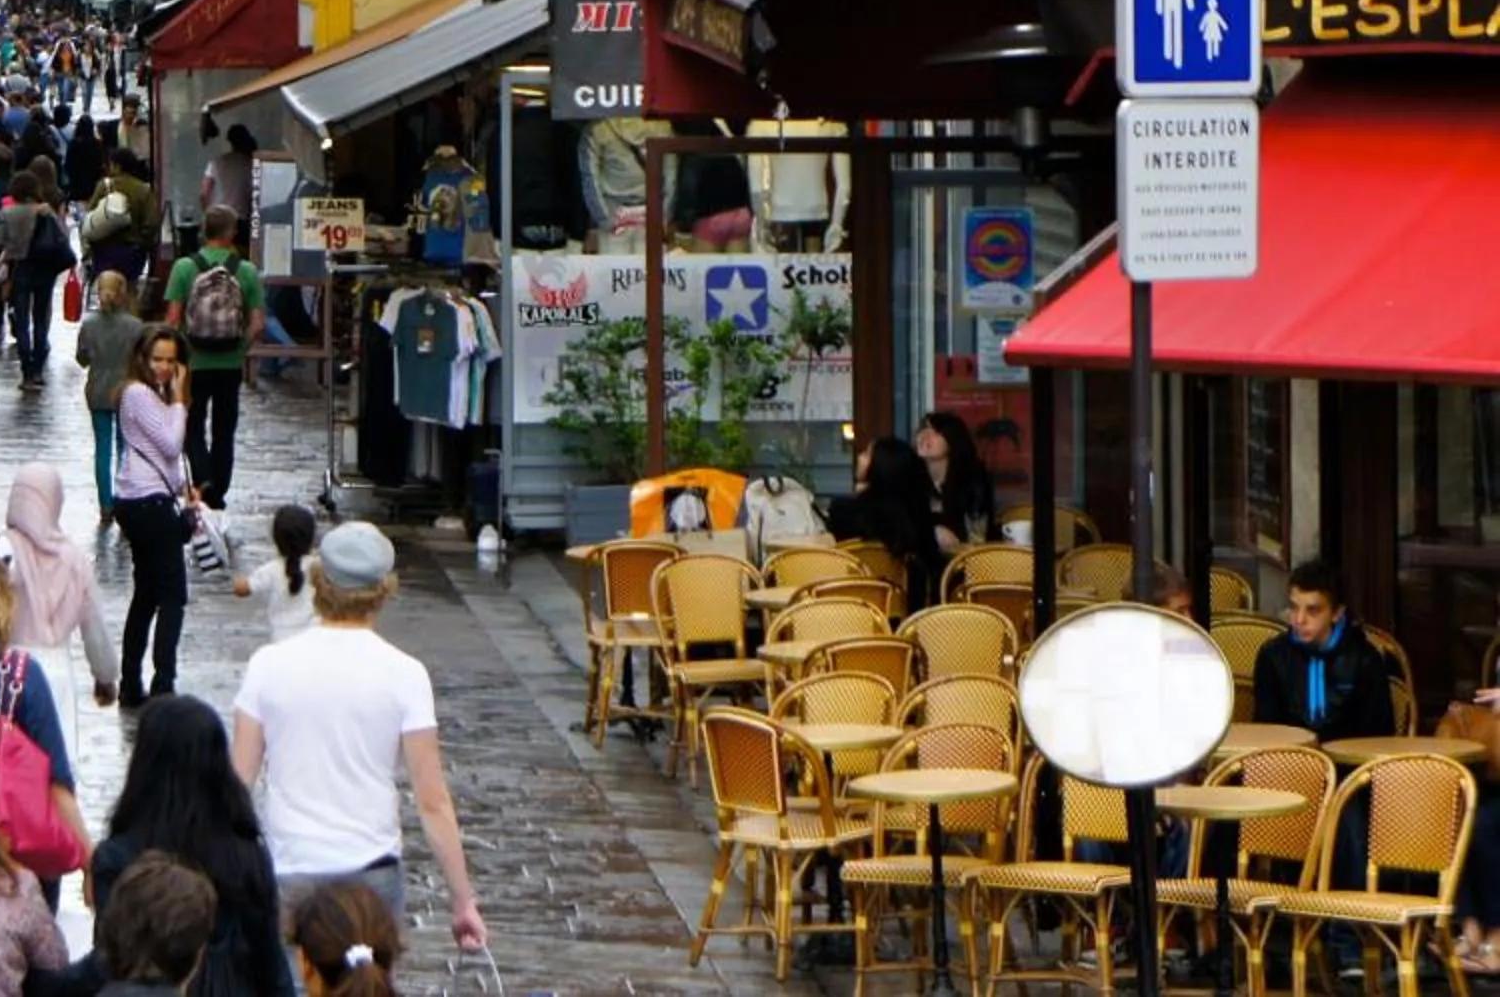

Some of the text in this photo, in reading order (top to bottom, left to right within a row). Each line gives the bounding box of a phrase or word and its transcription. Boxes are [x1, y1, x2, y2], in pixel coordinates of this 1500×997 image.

[572, 1, 644, 33] MI
[1132, 118, 1250, 138] CIRCULATION
[1144, 150, 1237, 170] INTERDITE
[308, 200, 358, 210] JEANS
[782, 264, 852, 289] Schot
[520, 303, 598, 326] KAPORALS
